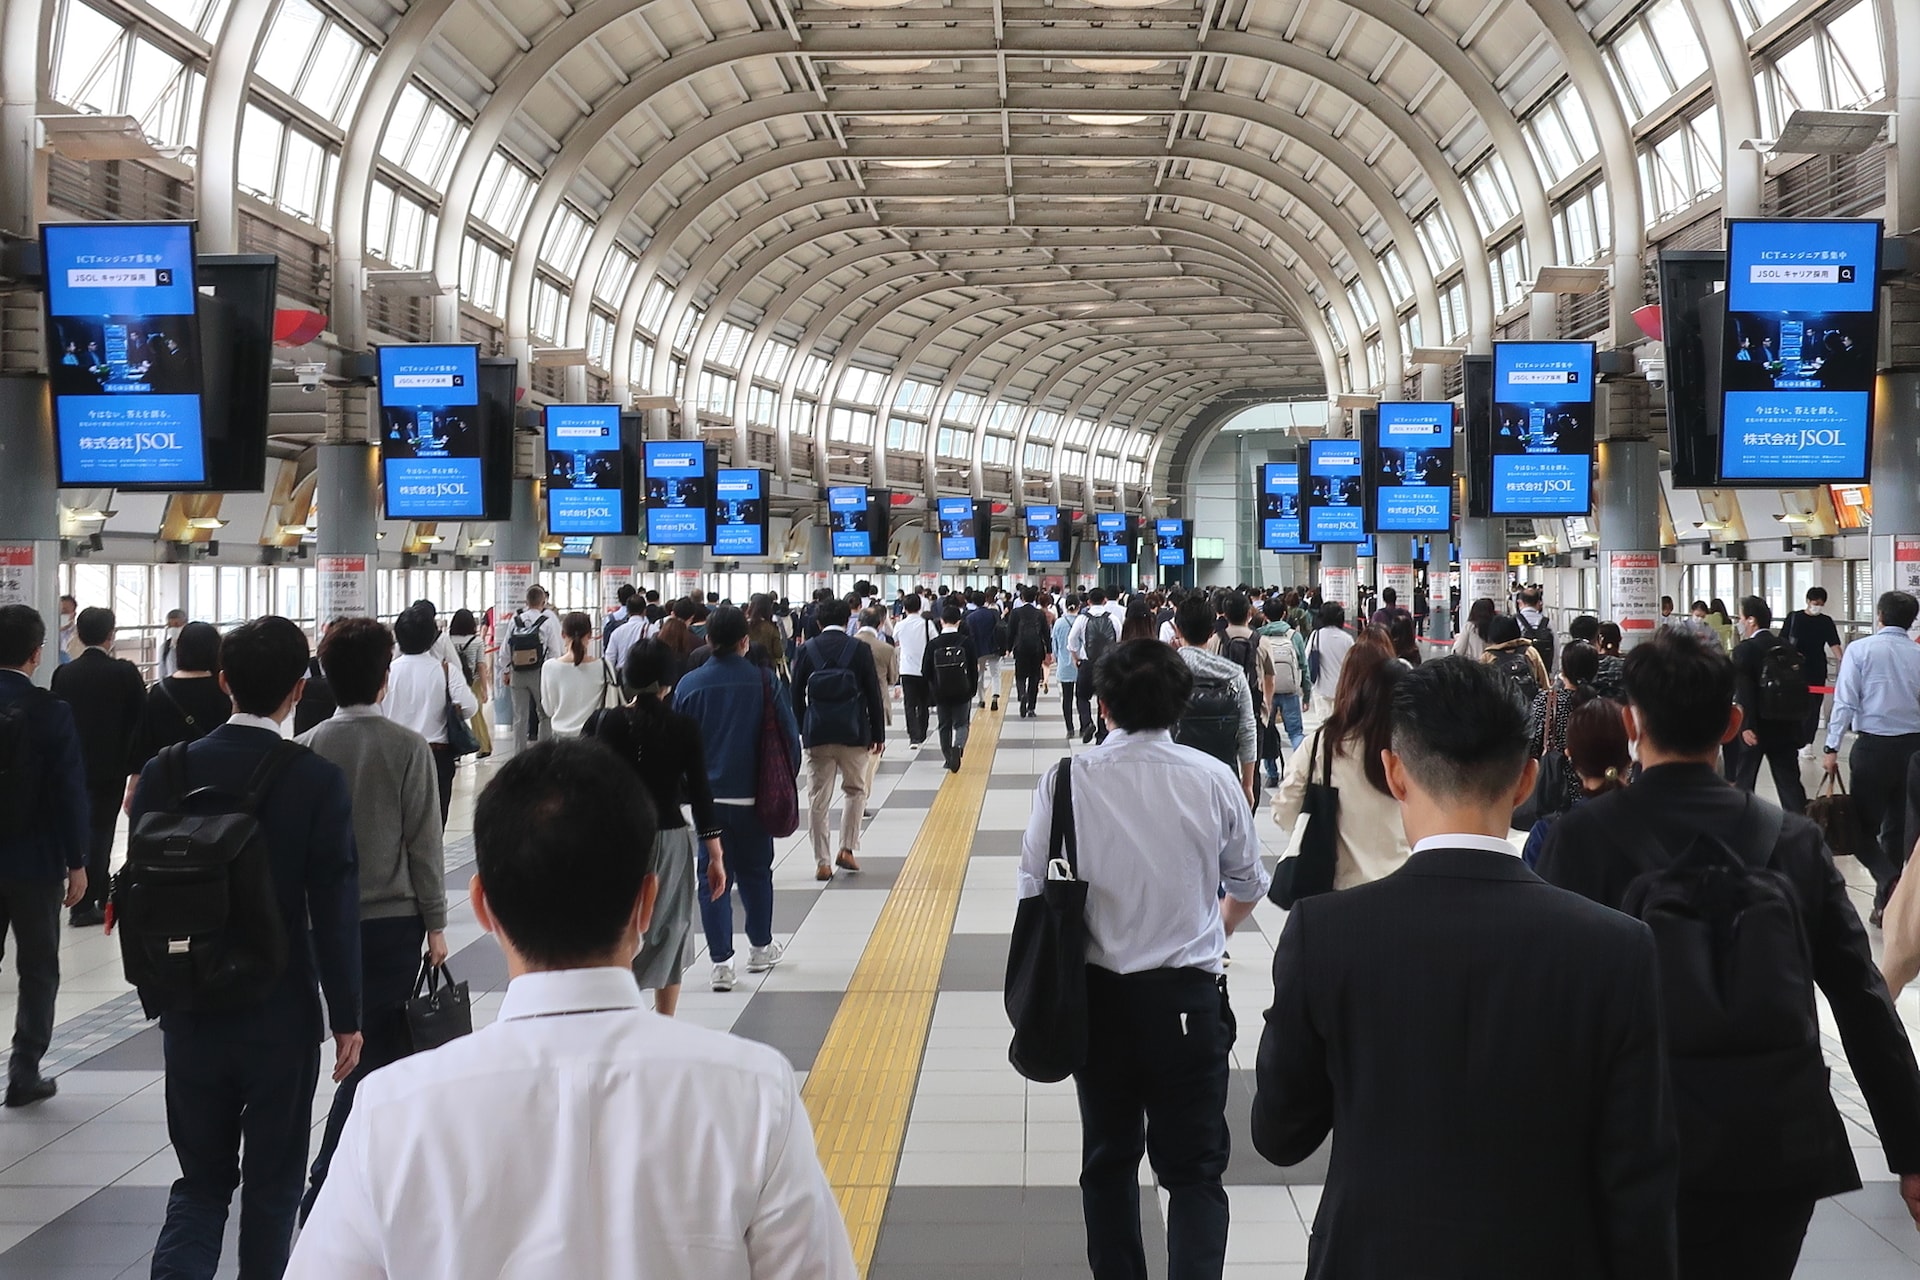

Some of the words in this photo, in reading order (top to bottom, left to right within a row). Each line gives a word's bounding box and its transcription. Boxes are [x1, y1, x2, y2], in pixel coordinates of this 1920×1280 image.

[1761, 251, 1847, 260] ICTエンジニア募集中
[74, 273, 98, 282] JSOL
[101, 273, 146, 282] キャリア採用
[1757, 270, 1781, 278] JSOL
[1783, 270, 1829, 278] キャリア採用
[79, 432, 184, 456] 株式会社JSOL
[1742, 429, 1847, 451] 株式会社JSOL
[400, 483, 469, 498] 株式会社JSOL
[1506, 479, 1576, 494] 株式会社JSOL
